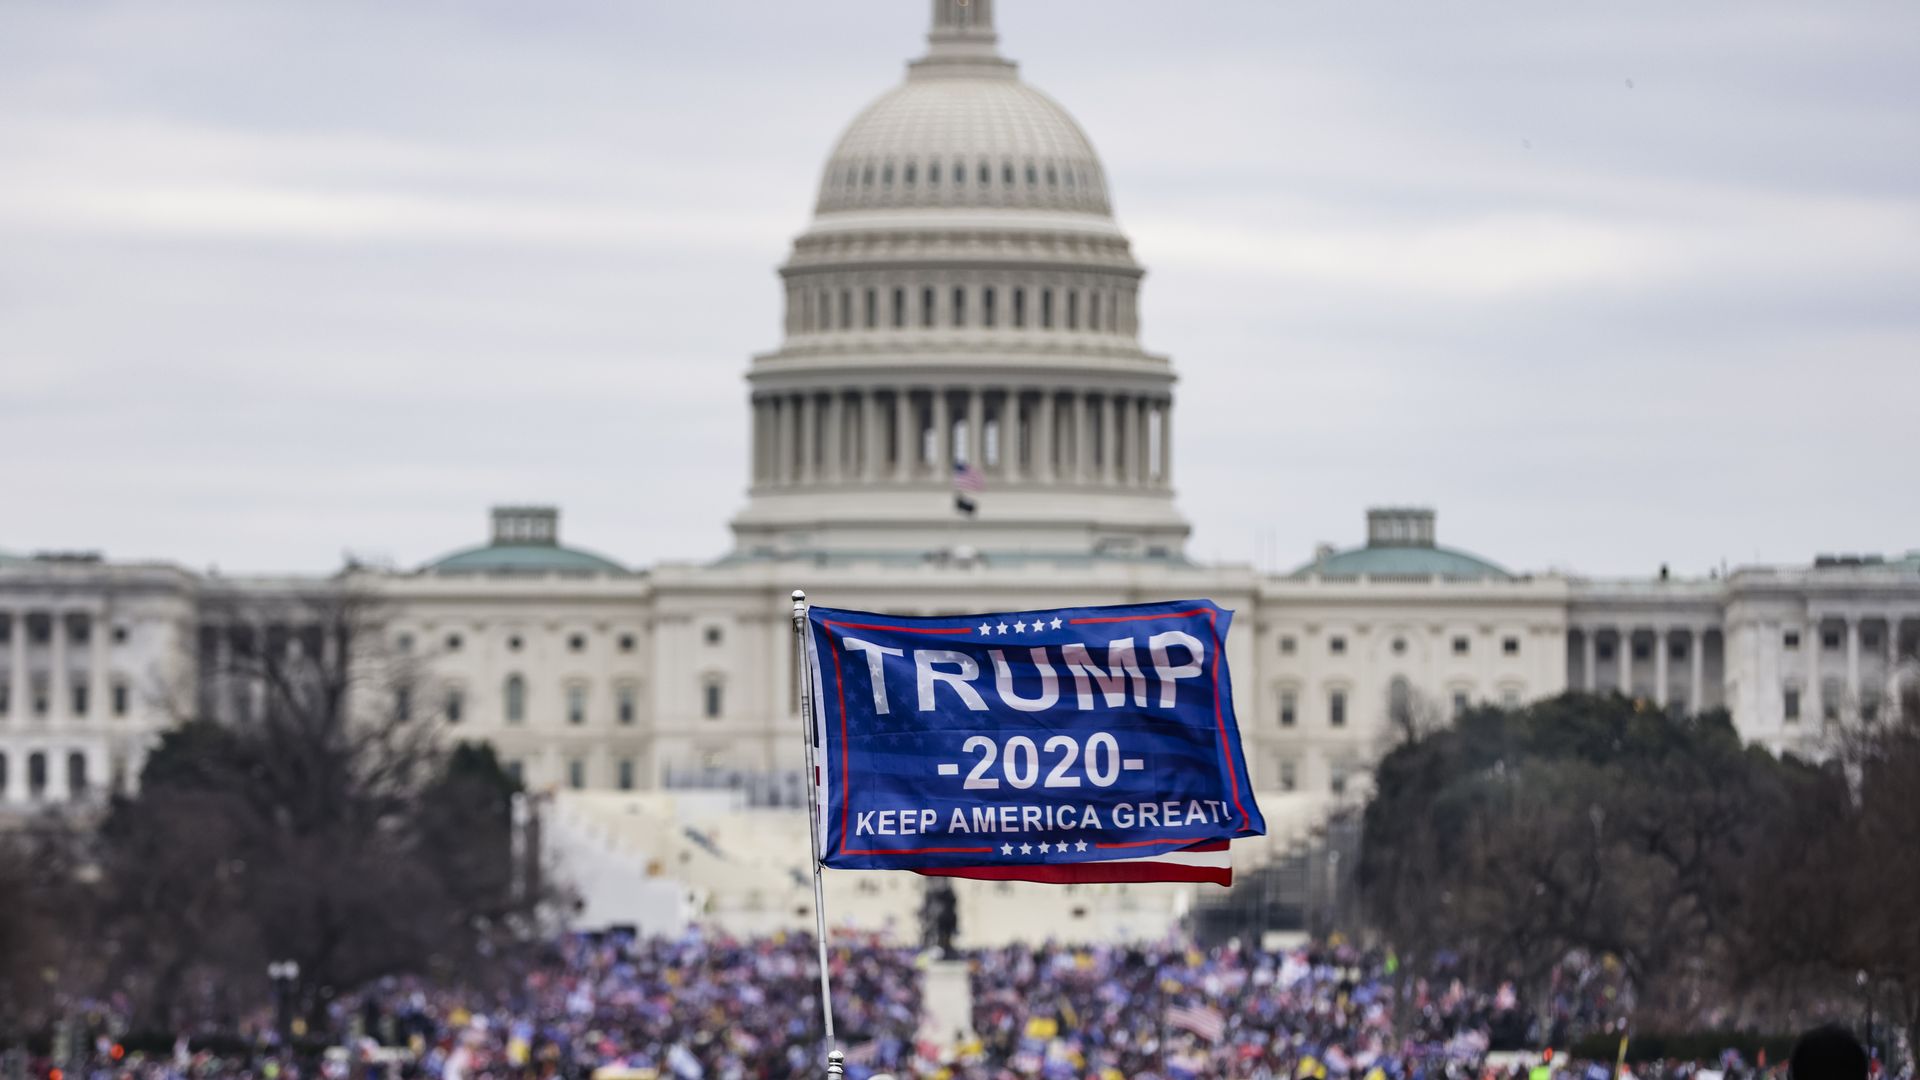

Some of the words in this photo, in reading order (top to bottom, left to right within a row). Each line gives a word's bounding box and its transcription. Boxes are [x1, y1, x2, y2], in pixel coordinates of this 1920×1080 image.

[843, 630, 1204, 715] TRUMP
[938, 732, 1144, 789] -2020-
[855, 808, 937, 836] KEEP
[948, 804, 1102, 834] AMERICA
[1112, 799, 1233, 828] GREAT!
